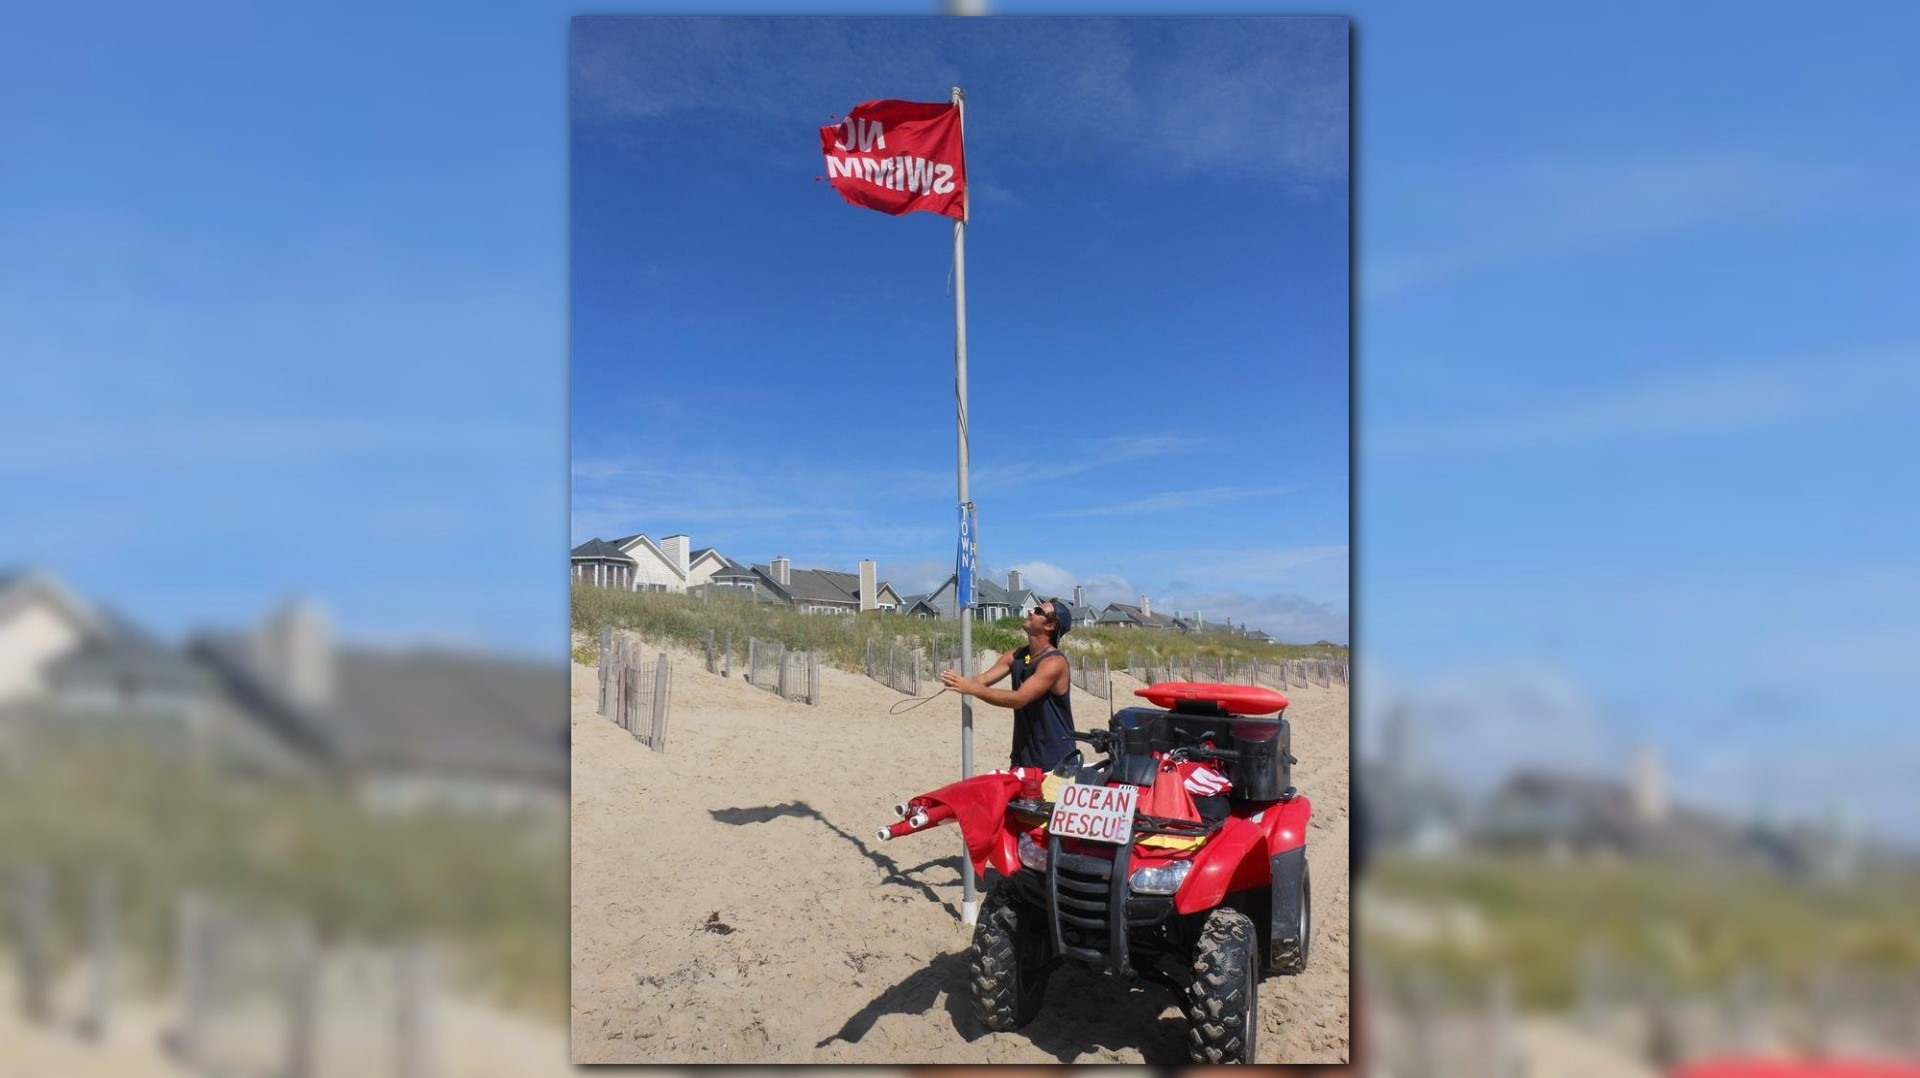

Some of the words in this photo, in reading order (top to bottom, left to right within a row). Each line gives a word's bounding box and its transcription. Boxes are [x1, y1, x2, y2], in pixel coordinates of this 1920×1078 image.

[961, 505, 969, 568] TOWN
[1063, 785, 1130, 814] OCEAN
[1052, 810, 1127, 841] RESCUE
